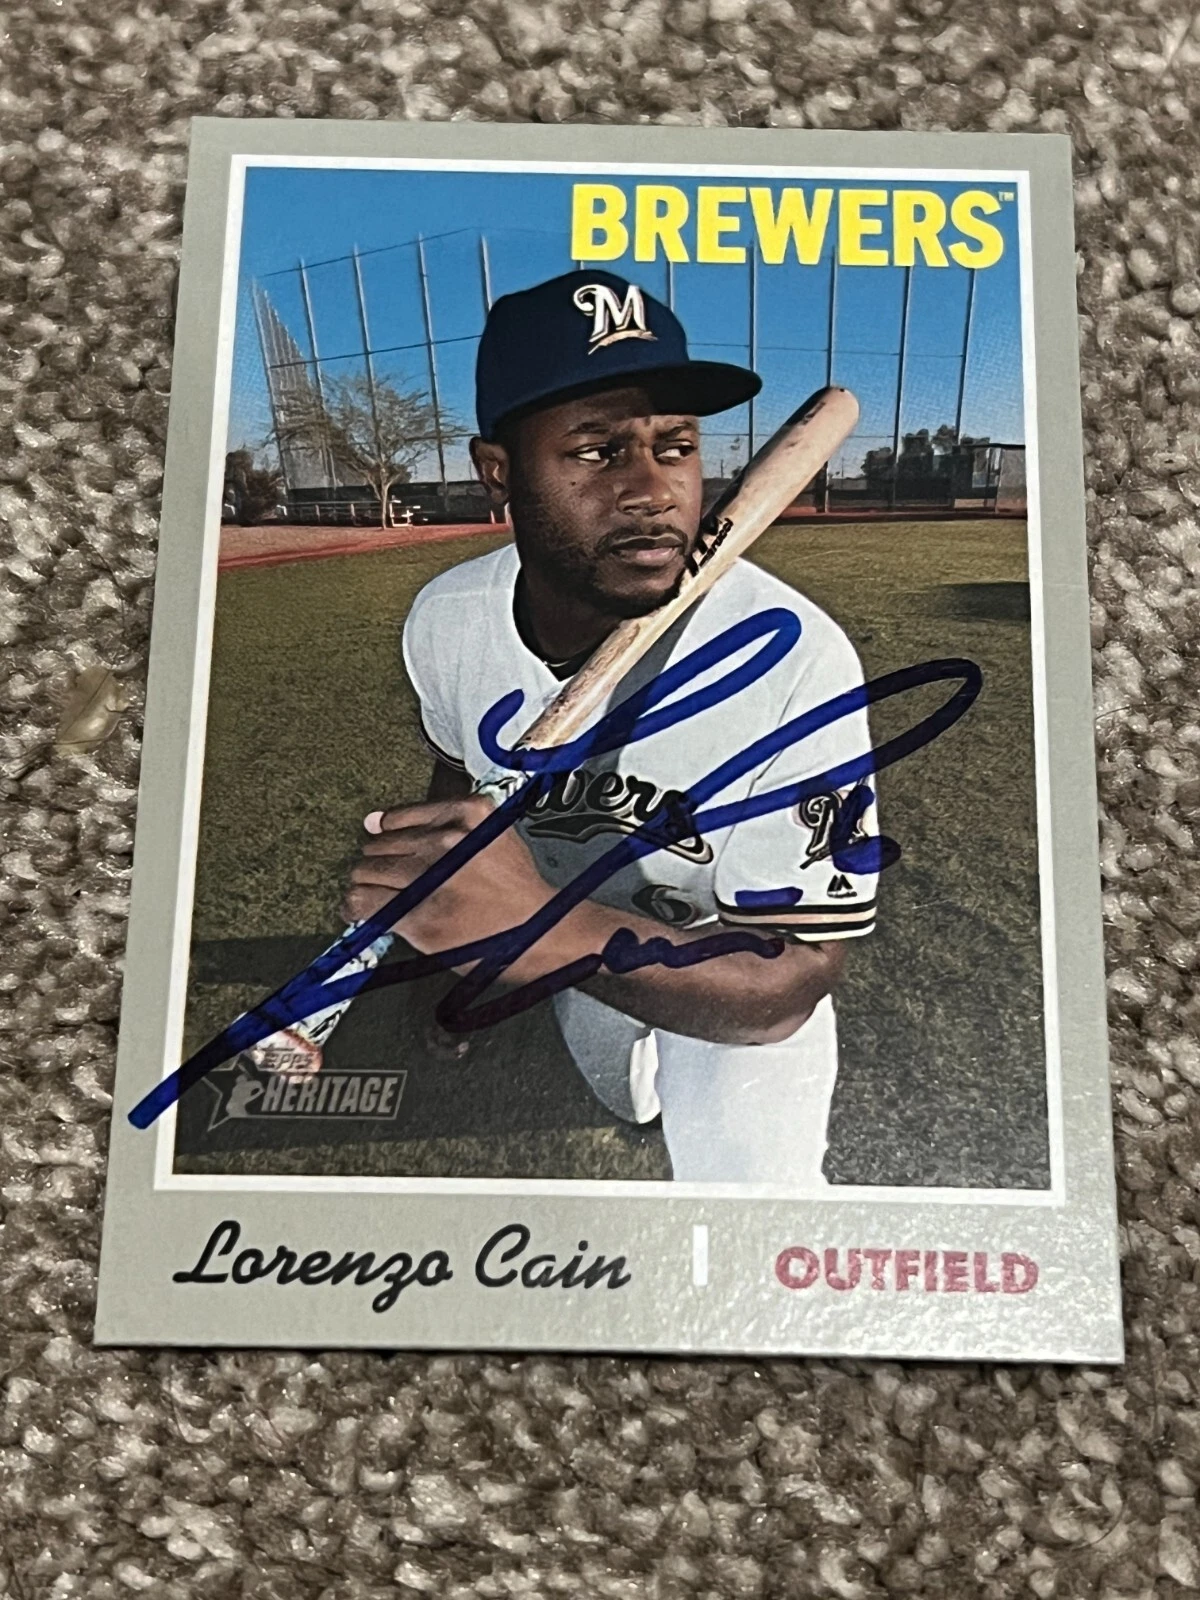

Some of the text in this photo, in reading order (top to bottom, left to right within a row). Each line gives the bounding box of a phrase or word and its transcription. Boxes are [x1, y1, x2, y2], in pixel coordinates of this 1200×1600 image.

[571, 183, 1004, 270] BREWERS
[261, 1074, 399, 1113] HERITAGE
[172, 1219, 632, 1314] Lorenzo Cain
[774, 1245, 1040, 1295] OUTFIELD
